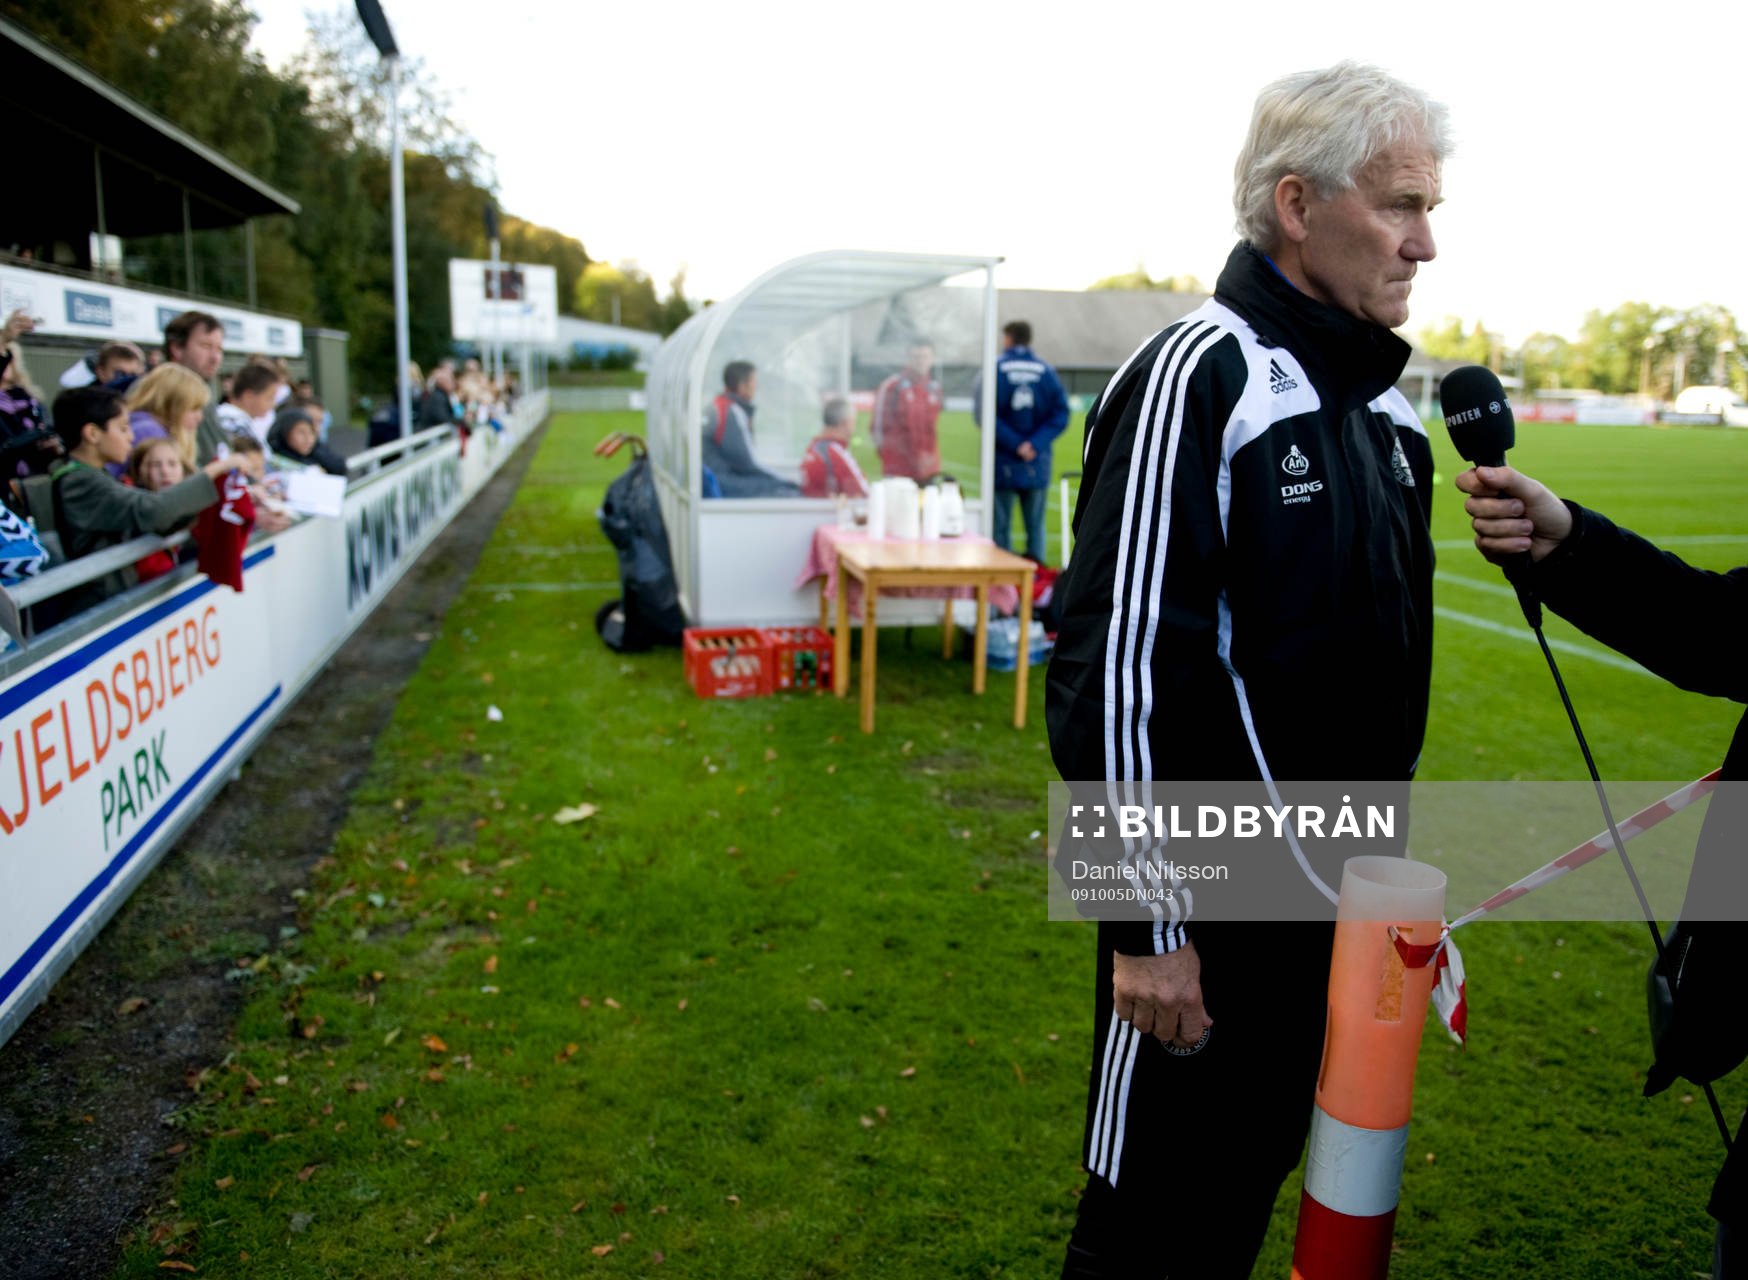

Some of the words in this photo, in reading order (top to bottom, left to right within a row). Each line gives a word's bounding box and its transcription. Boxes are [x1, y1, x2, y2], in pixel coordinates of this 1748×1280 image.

[1281, 480, 1323, 497] DONG
[1283, 495, 1311, 505] energy
[100, 729, 171, 851] PARK
